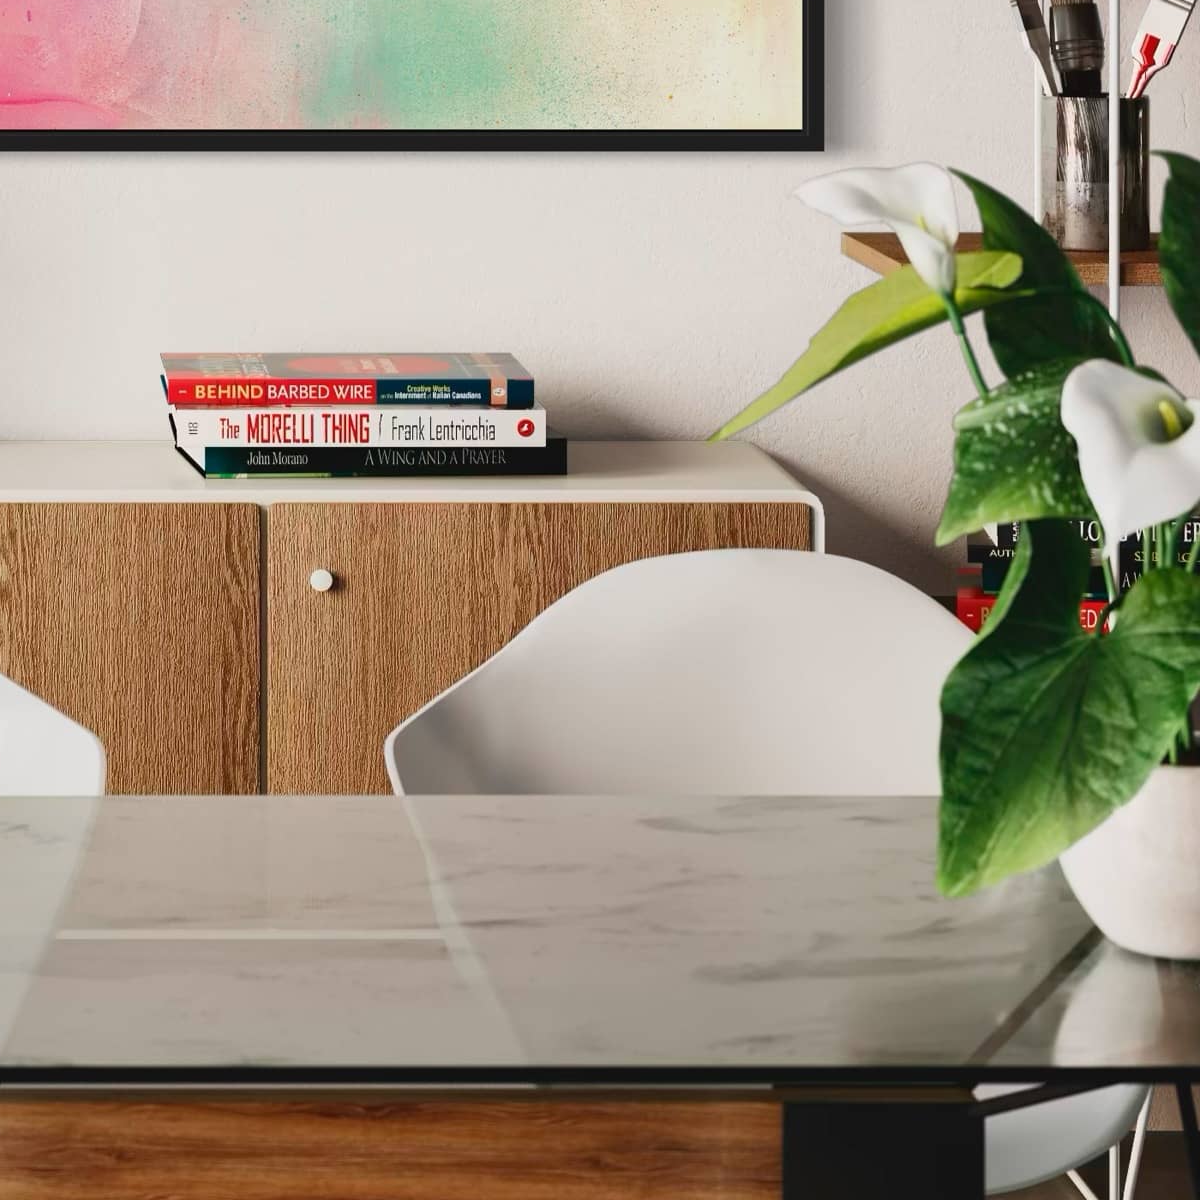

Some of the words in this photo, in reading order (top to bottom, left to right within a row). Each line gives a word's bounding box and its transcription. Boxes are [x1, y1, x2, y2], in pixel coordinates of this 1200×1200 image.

[195, 384, 263, 399] BEHIND
[267, 384, 329, 399] BARBED
[332, 384, 373, 399] WIRE
[407, 384, 431, 392] Creative
[432, 384, 451, 392] Works
[394, 392, 427, 400] Internment
[432, 392, 451, 400] Italian
[451, 392, 482, 400] Canadians
[220, 418, 240, 439] The
[247, 413, 314, 443] MORELLI
[322, 413, 370, 443] THING
[391, 416, 425, 441] Frank
[429, 416, 496, 441] Lentricchia
[247, 451, 270, 465] John
[272, 452, 309, 465] Morano
[364, 450, 375, 466] A
[418, 450, 448, 466] AND
